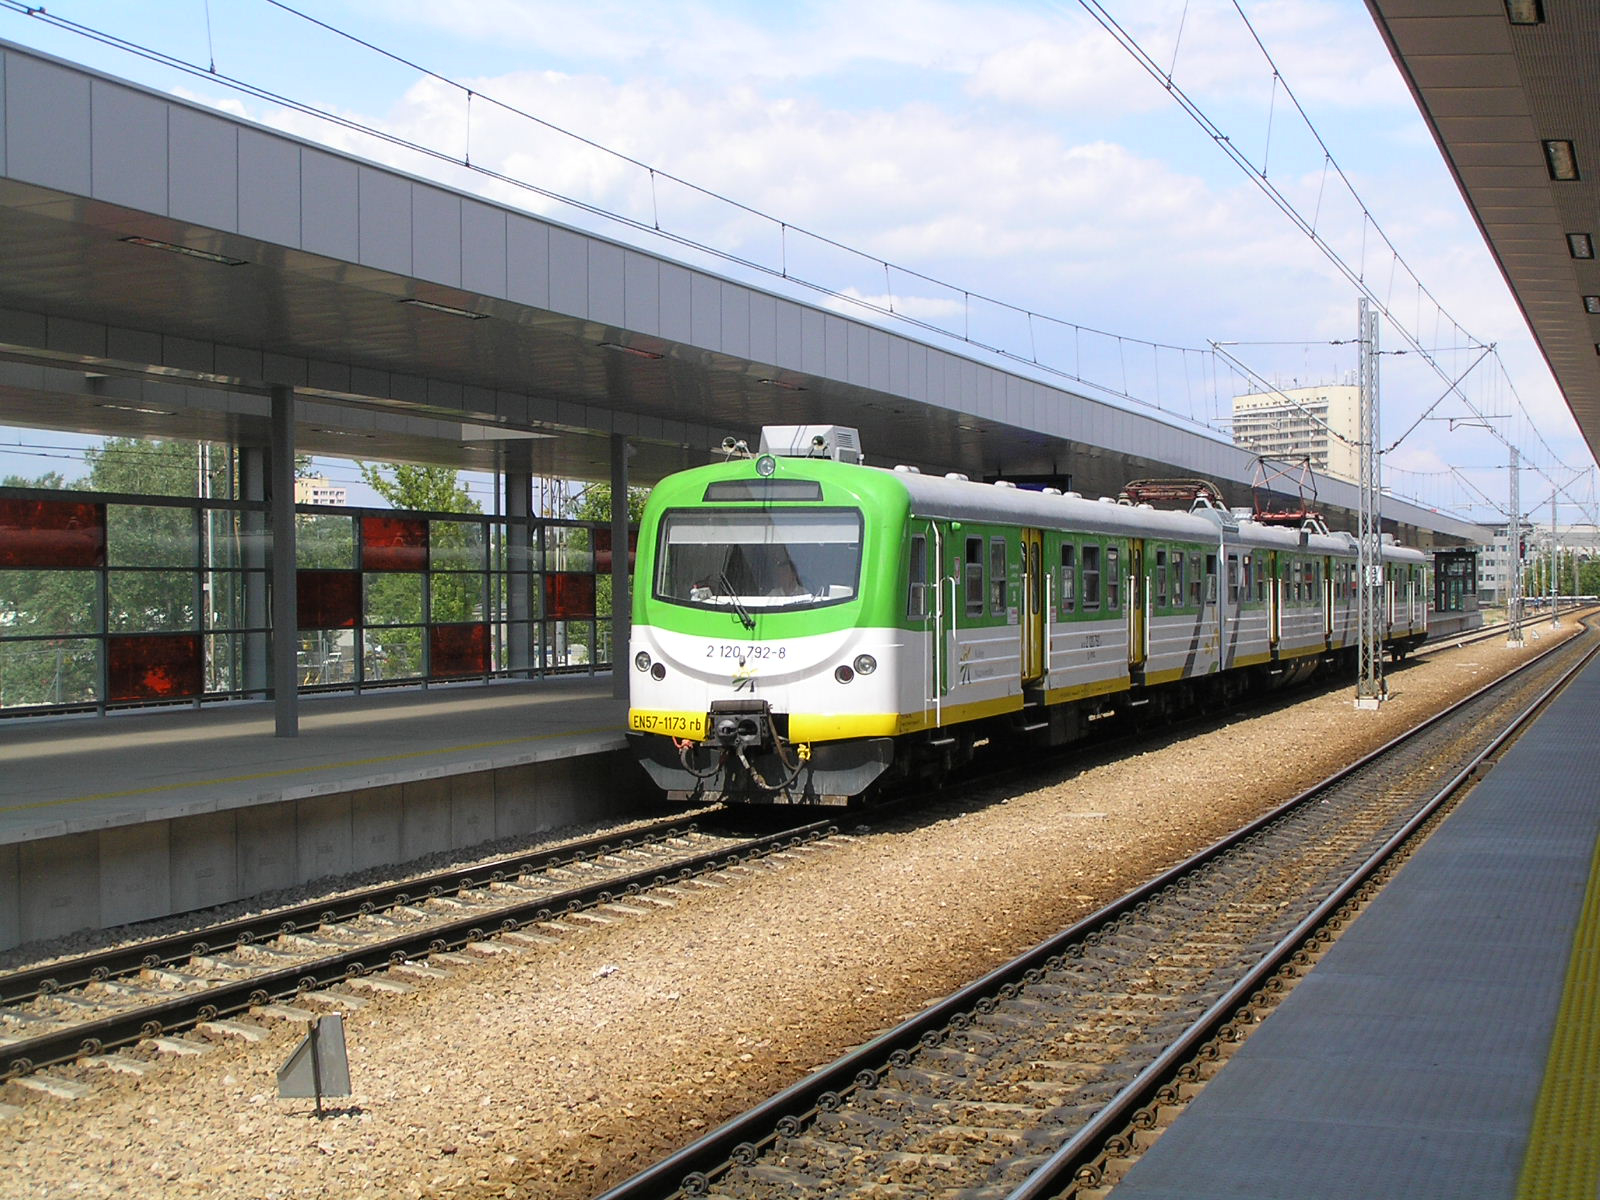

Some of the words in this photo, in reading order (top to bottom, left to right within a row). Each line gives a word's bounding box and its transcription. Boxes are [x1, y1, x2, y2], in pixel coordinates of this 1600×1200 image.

[706, 645, 715, 658] 2
[720, 645, 741, 658] 120
[746, 646, 786, 660] 792-8
[633, 715, 686, 730] EN57-1173
[689, 718, 701, 731] rb
